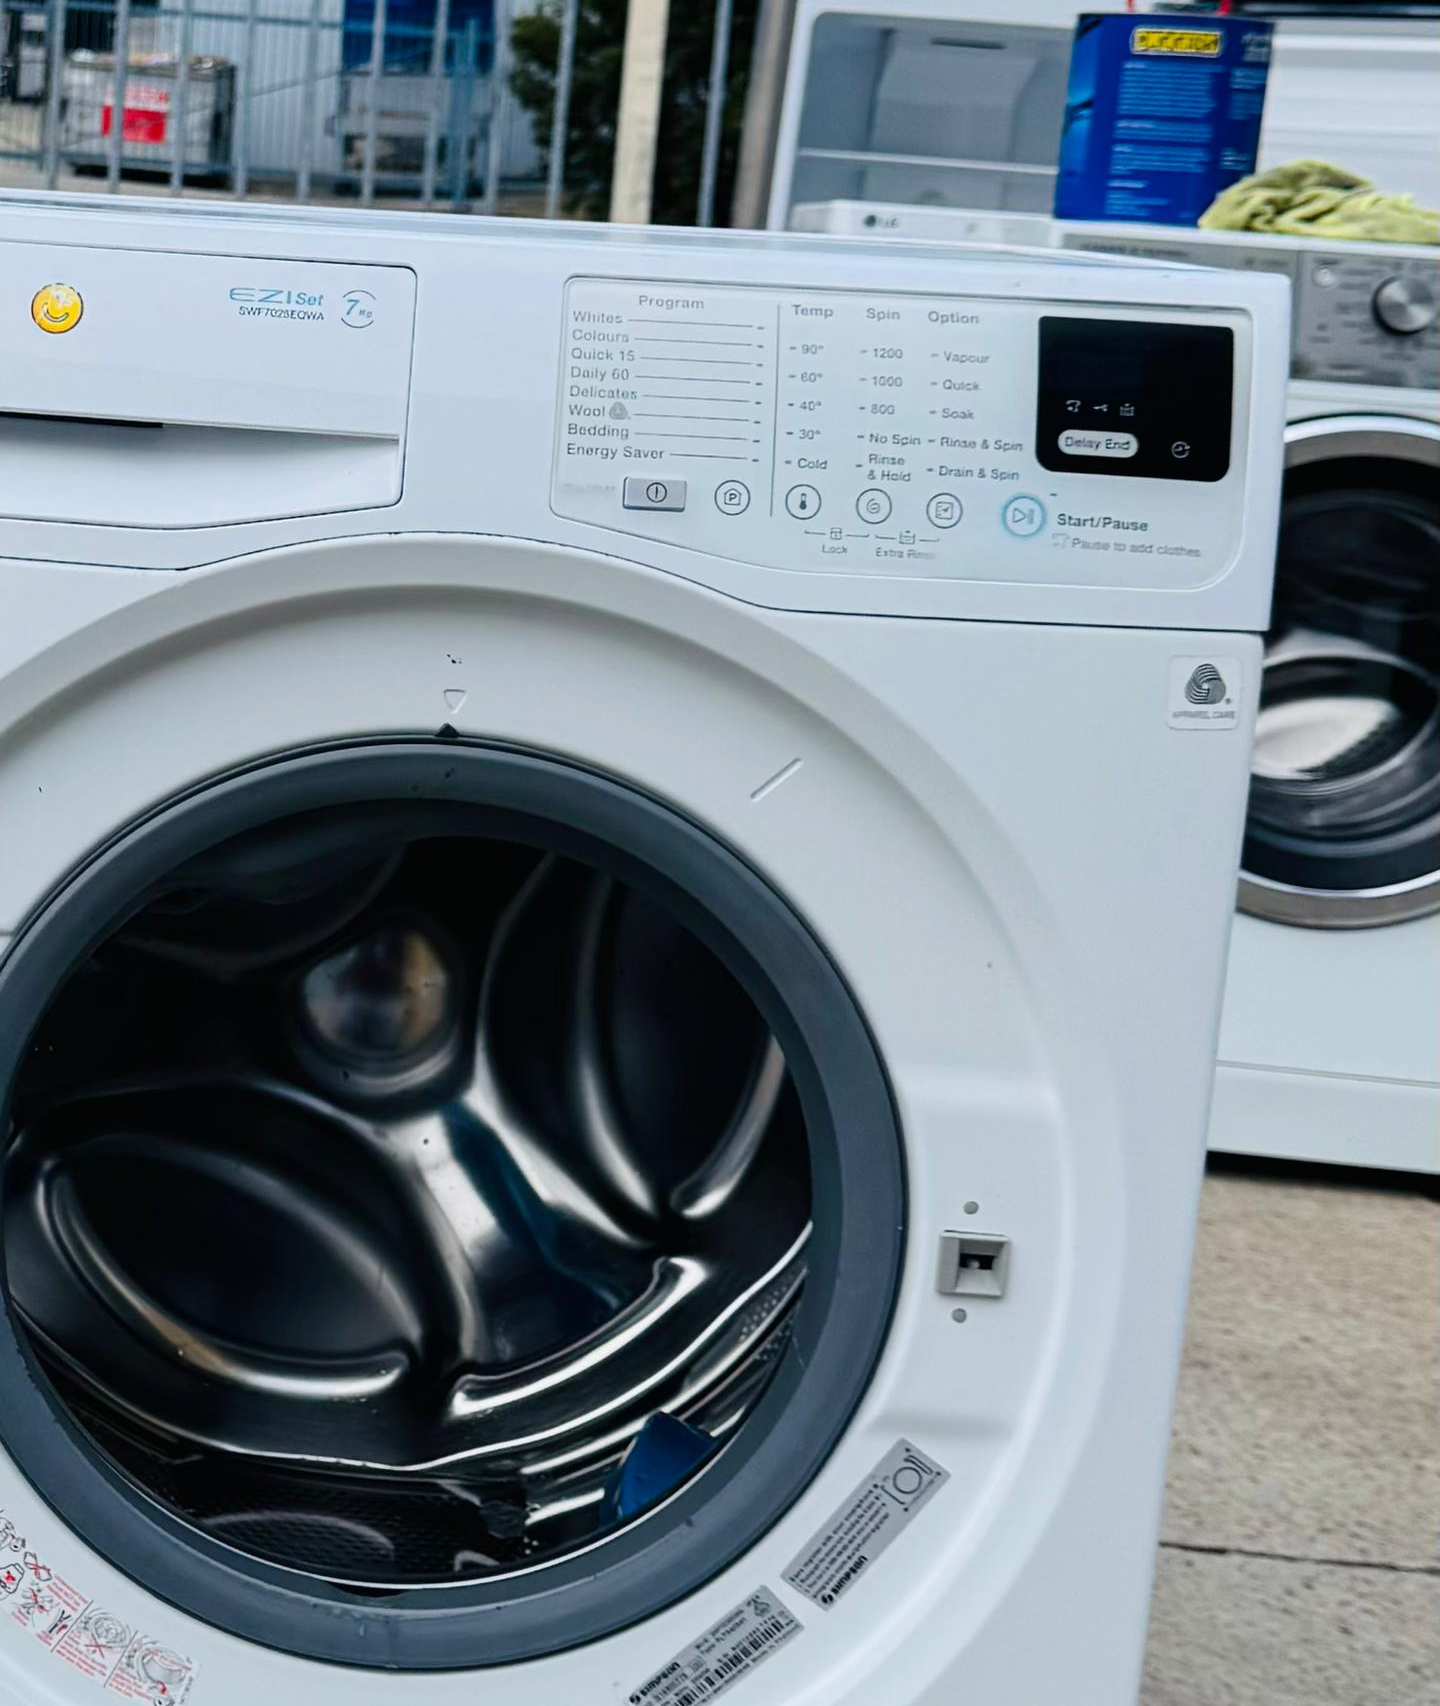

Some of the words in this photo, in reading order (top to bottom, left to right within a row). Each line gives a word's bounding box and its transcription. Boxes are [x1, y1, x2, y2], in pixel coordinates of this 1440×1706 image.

[638, 295, 705, 310] Program
[572, 310, 623, 324] Whites
[792, 304, 834, 320] Temp
[866, 308, 901, 322] Spin
[928, 311, 980, 325] Option
[572, 328, 630, 343] Colours
[571, 347, 614, 362] Quick
[619, 350, 636, 362] 15
[872, 348, 903, 359] 1200
[943, 351, 990, 364] Vapour
[570, 366, 607, 382] Daily
[612, 368, 630, 381] 60
[871, 376, 903, 388] 1000
[942, 379, 980, 391] Quick
[569, 385, 638, 400] Delicates
[568, 404, 606, 418] Wool
[870, 404, 895, 415] 800
[941, 408, 975, 420] Soak
[567, 423, 629, 440] Bedding
[868, 432, 888, 444] No
[892, 434, 921, 446] Spin
[940, 436, 976, 449] Rinse
[993, 439, 1023, 453] Spin
[1064, 436, 1101, 451] Delay
[1105, 439, 1131, 451] End
[567, 443, 618, 459] Energy
[623, 445, 665, 459] Saver
[797, 458, 828, 470] Cold
[868, 453, 905, 466] Rinse
[881, 470, 912, 483] Hold
[939, 465, 974, 478] Drain
[990, 469, 1020, 481] Spin
[1057, 513, 1149, 532] Start/Pause
